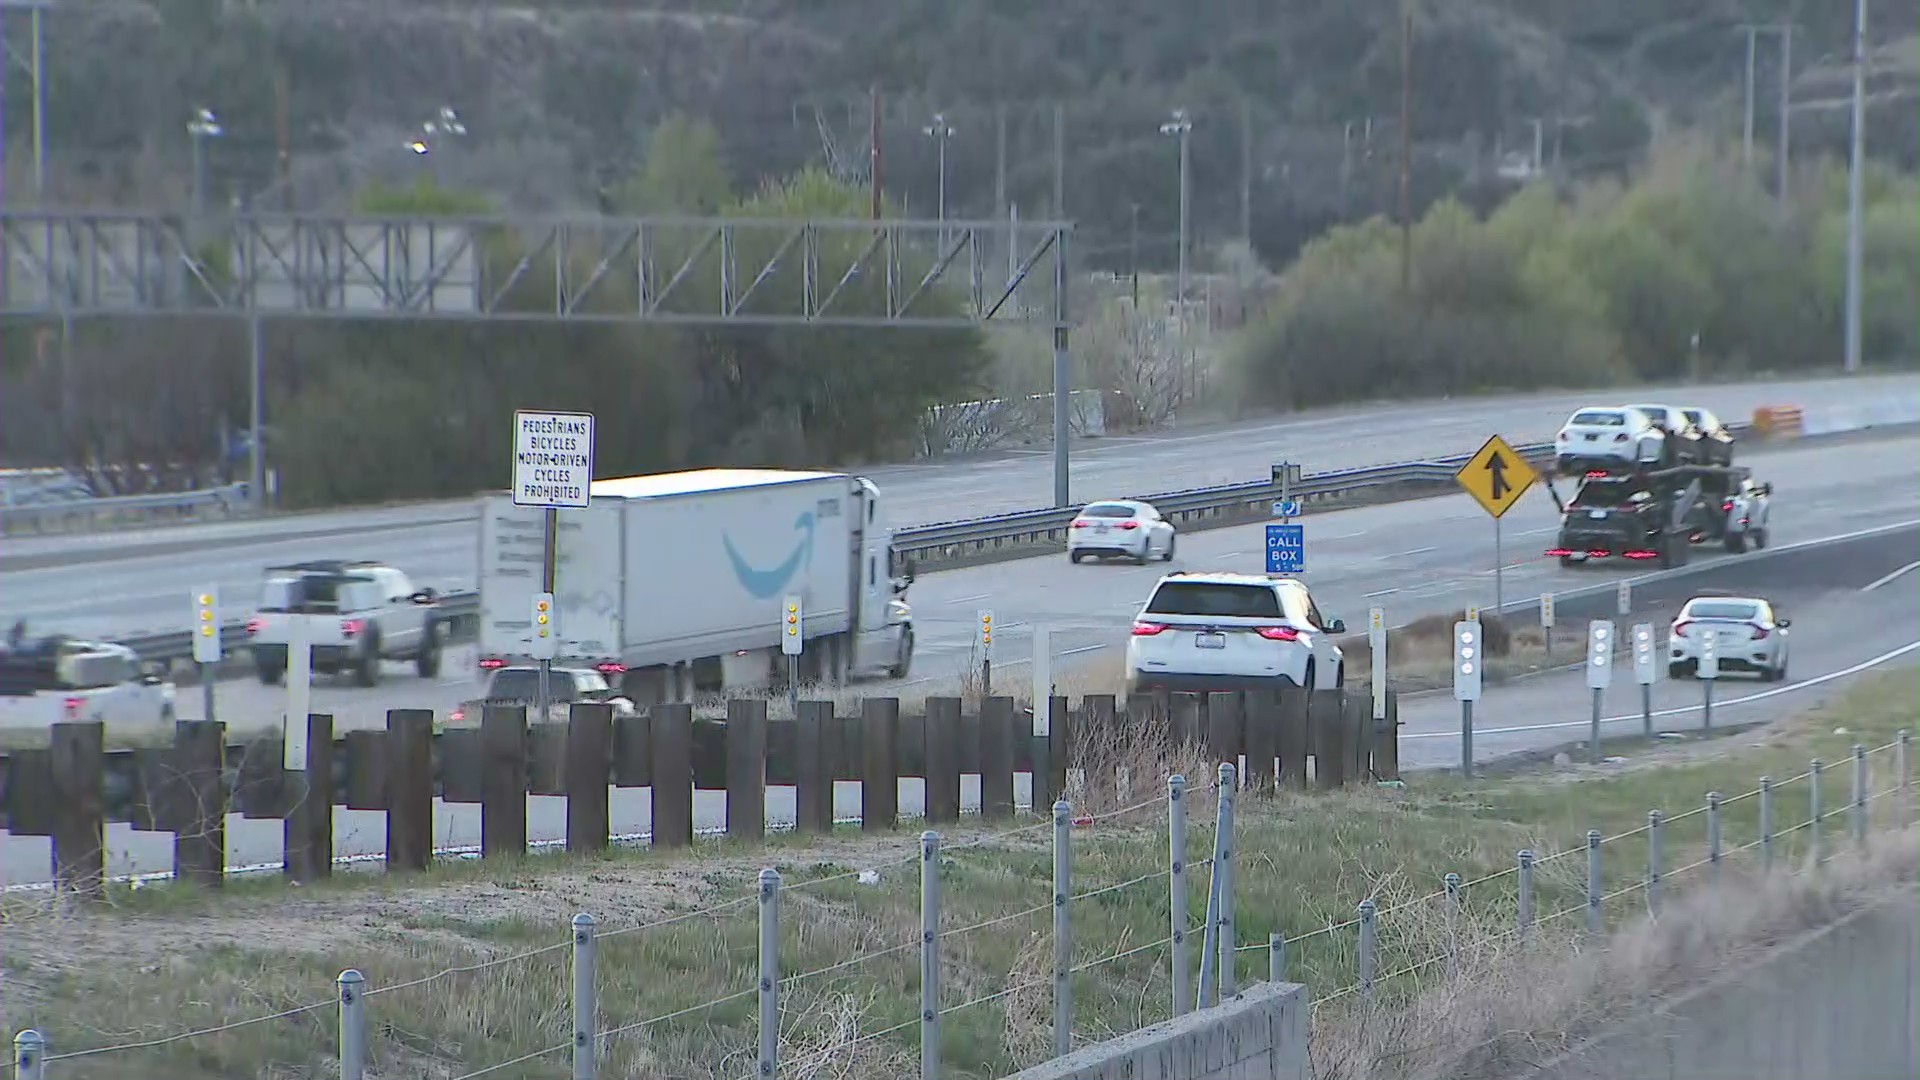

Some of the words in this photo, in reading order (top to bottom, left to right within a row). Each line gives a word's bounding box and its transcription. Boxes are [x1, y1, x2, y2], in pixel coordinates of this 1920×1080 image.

[523, 420, 586, 435] PEDESTRIANS
[531, 436, 576, 450] BICYCLES
[518, 452, 587, 467] MOTOR-DRIVEN
[534, 469, 570, 482] CYCLES
[524, 484, 580, 499] PROHIBITED
[1268, 537, 1300, 547] CALL
[1271, 551, 1296, 561] BOX
